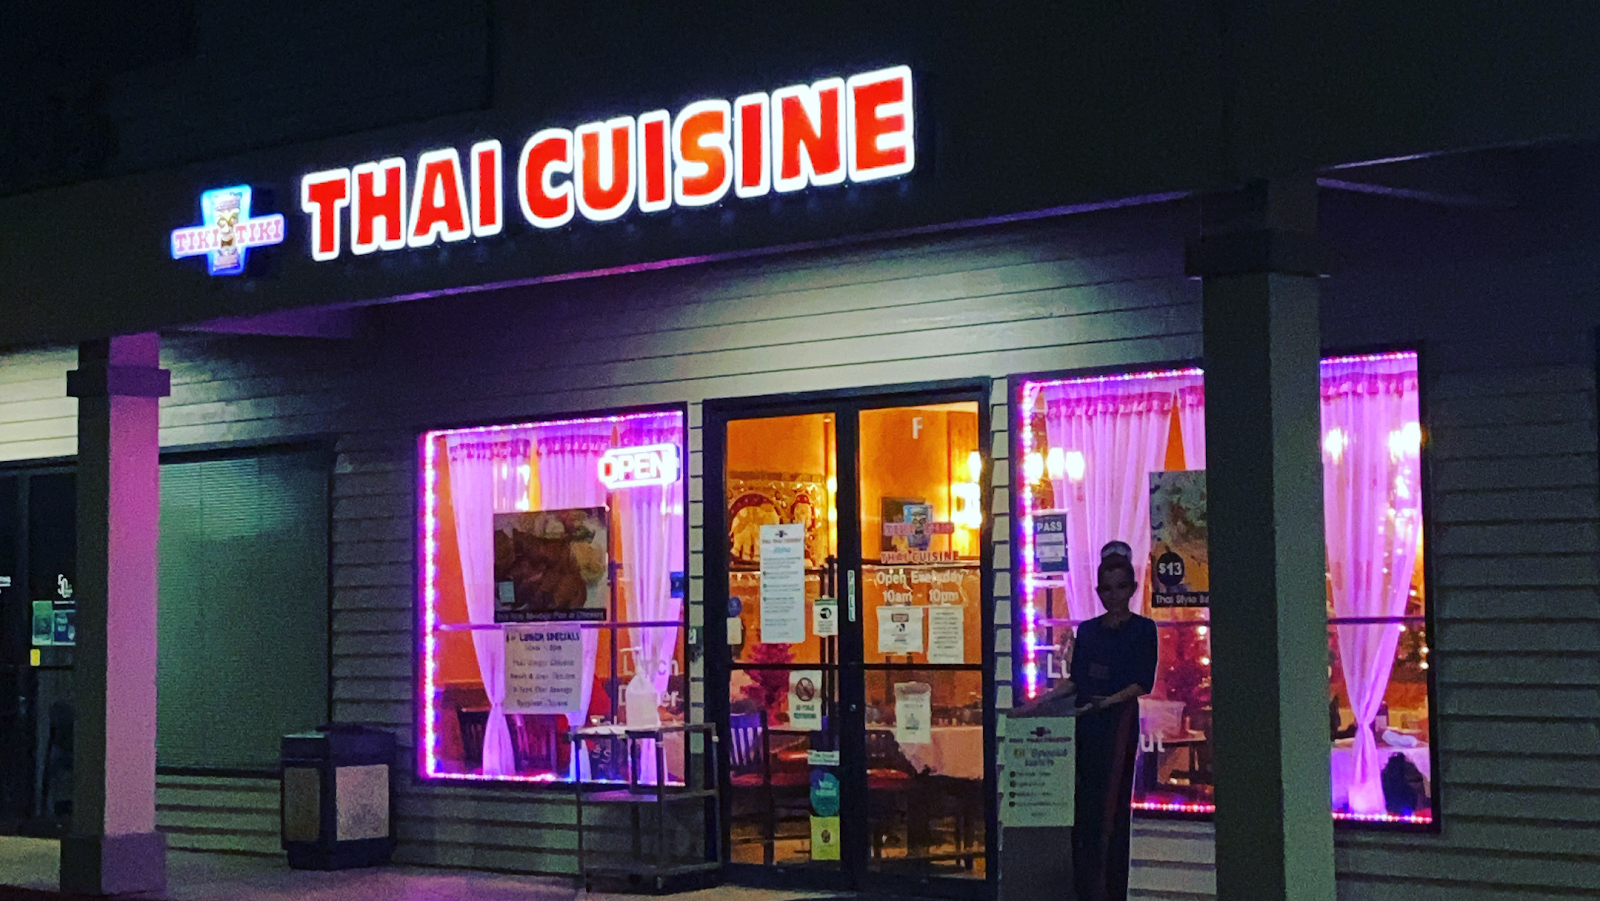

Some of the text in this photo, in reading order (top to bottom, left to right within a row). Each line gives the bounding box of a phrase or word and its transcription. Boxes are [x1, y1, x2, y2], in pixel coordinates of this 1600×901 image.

[301, 65, 915, 262] THAI CUISINE
[175, 219, 282, 253] TIKI TIKI
[912, 416, 924, 440] F
[599, 451, 671, 482] OPEN
[1036, 521, 1063, 532] PASS
[911, 550, 959, 564] CUISINE
[1158, 562, 1182, 576] $13
[876, 571, 907, 586] Open
[883, 590, 913, 604] 10am
[929, 588, 960, 605] 10pm
